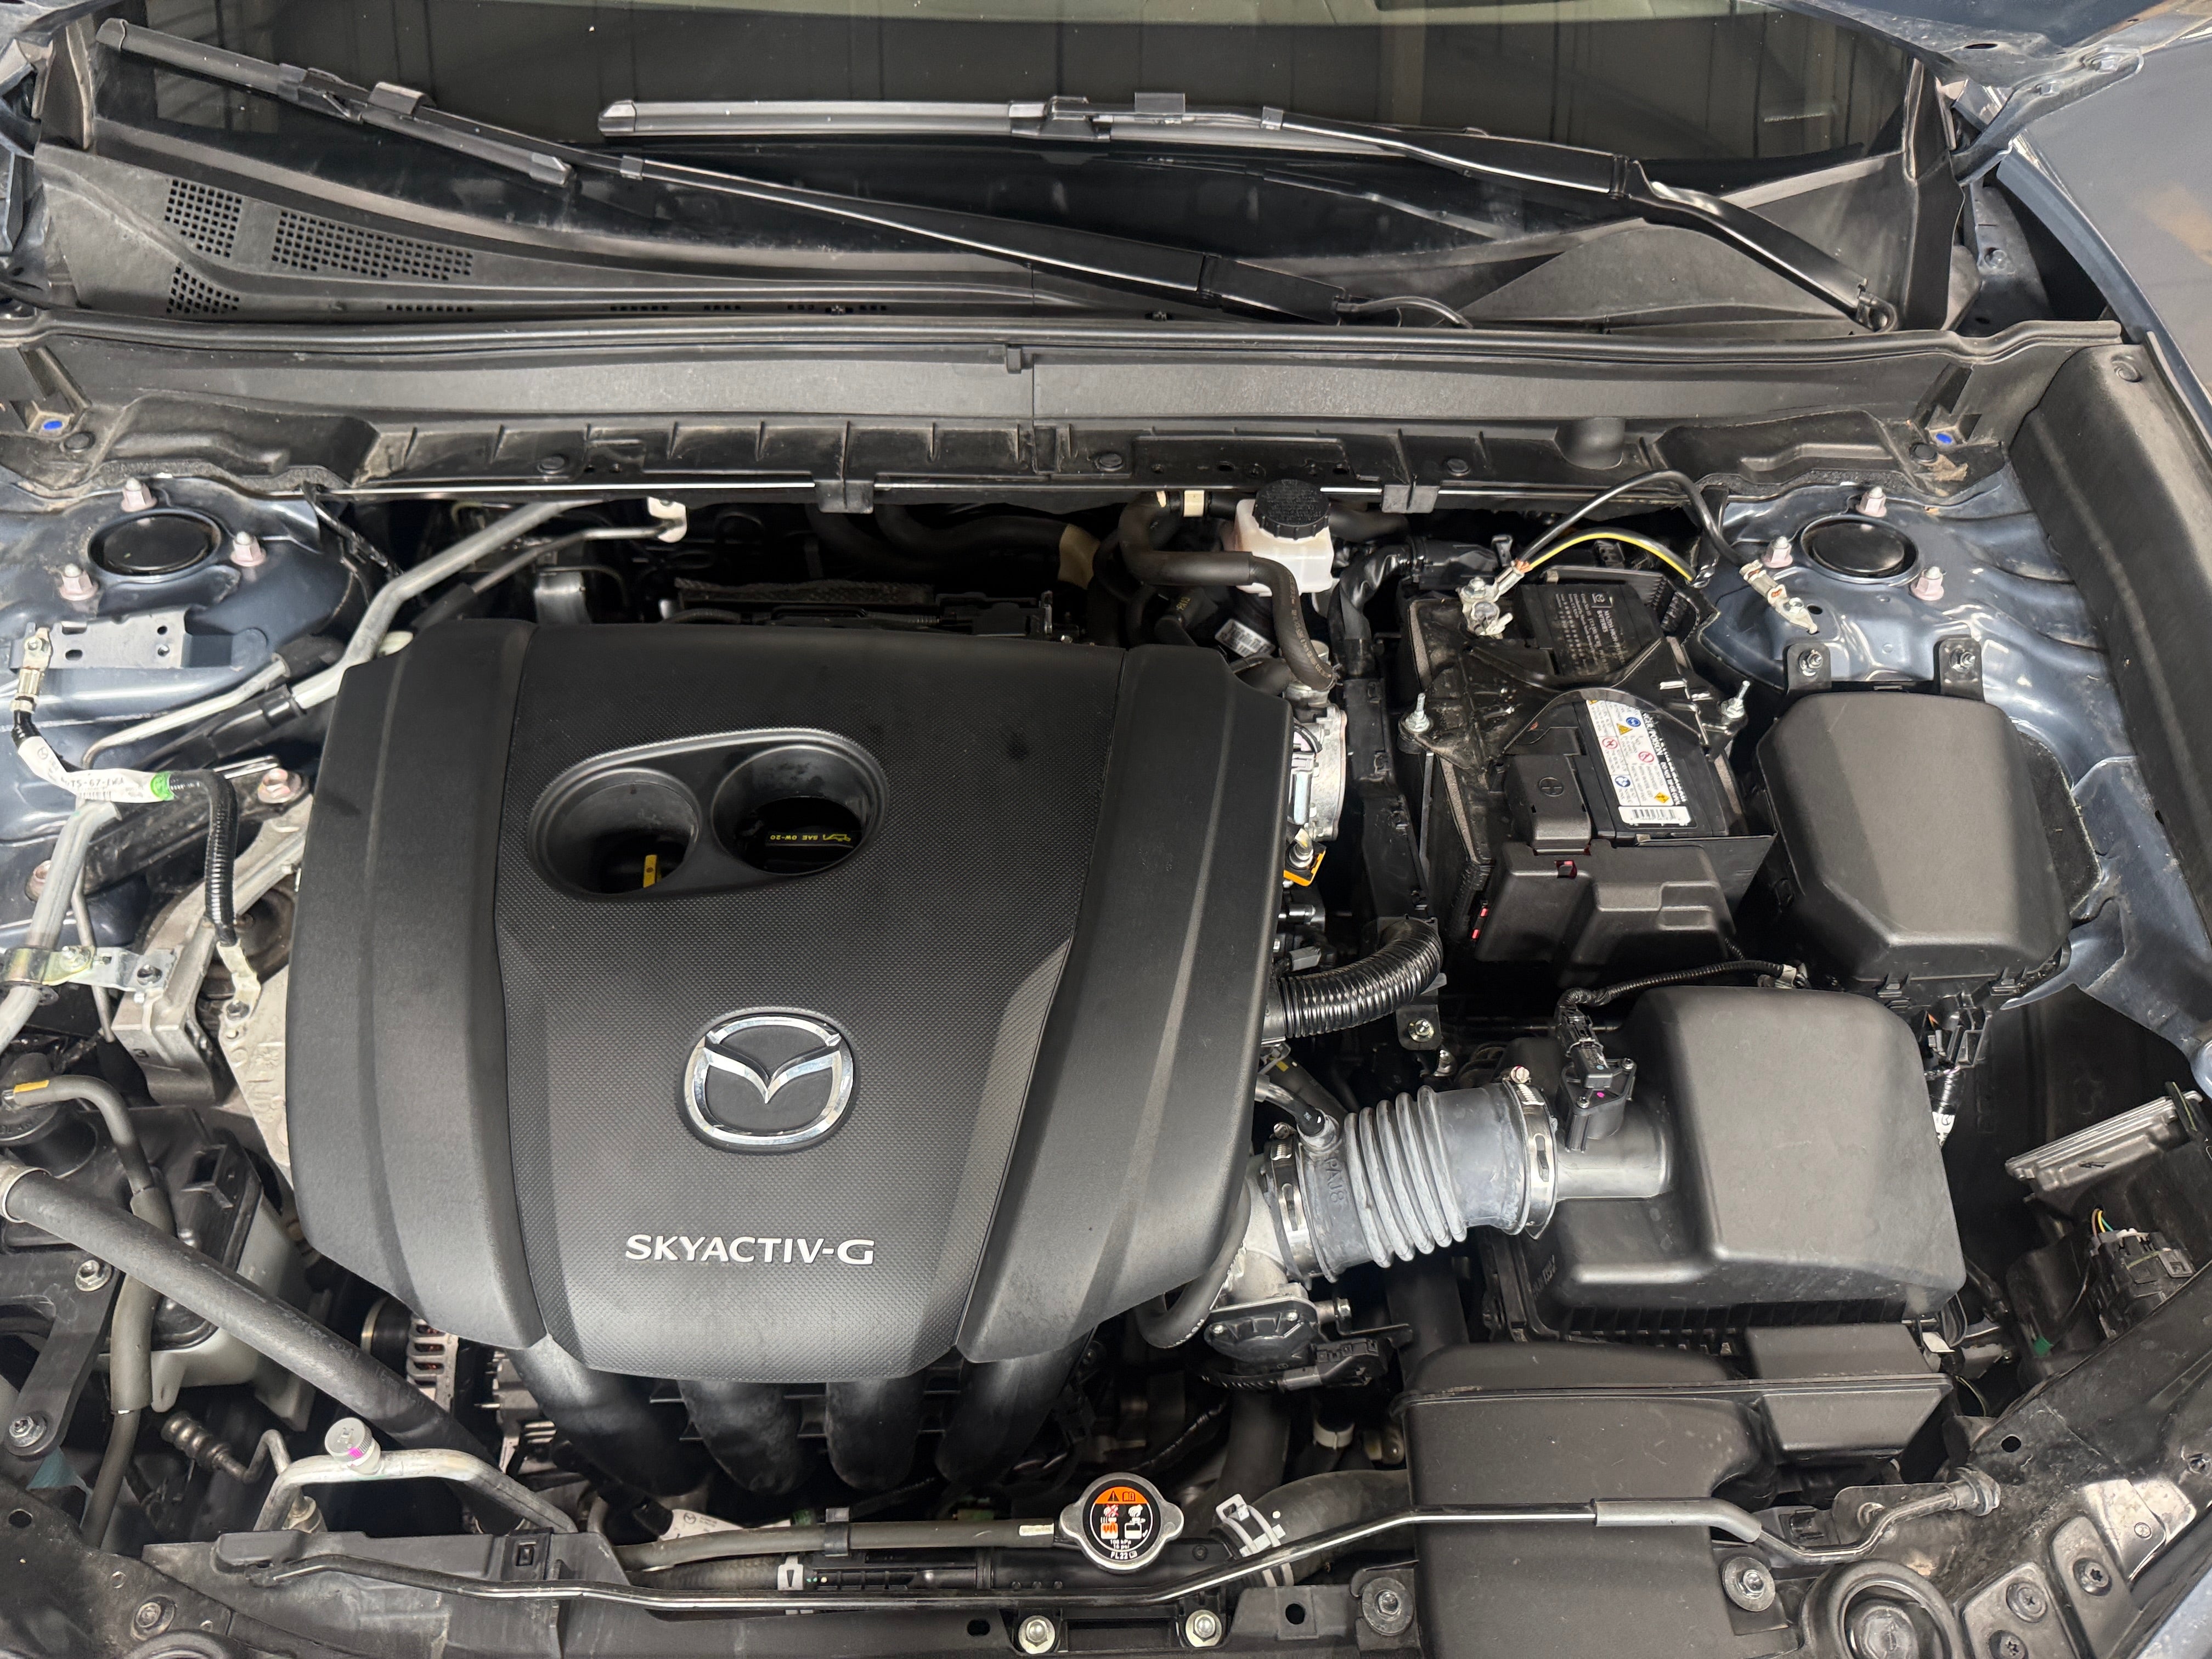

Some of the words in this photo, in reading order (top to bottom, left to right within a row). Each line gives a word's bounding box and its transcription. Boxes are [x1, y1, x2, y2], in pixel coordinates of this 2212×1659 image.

[1324, 1155, 1348, 1204] PAJ8
[625, 1234, 875, 1265] SKYACTIV-G
[1110, 1550, 1128, 1560] FL22
